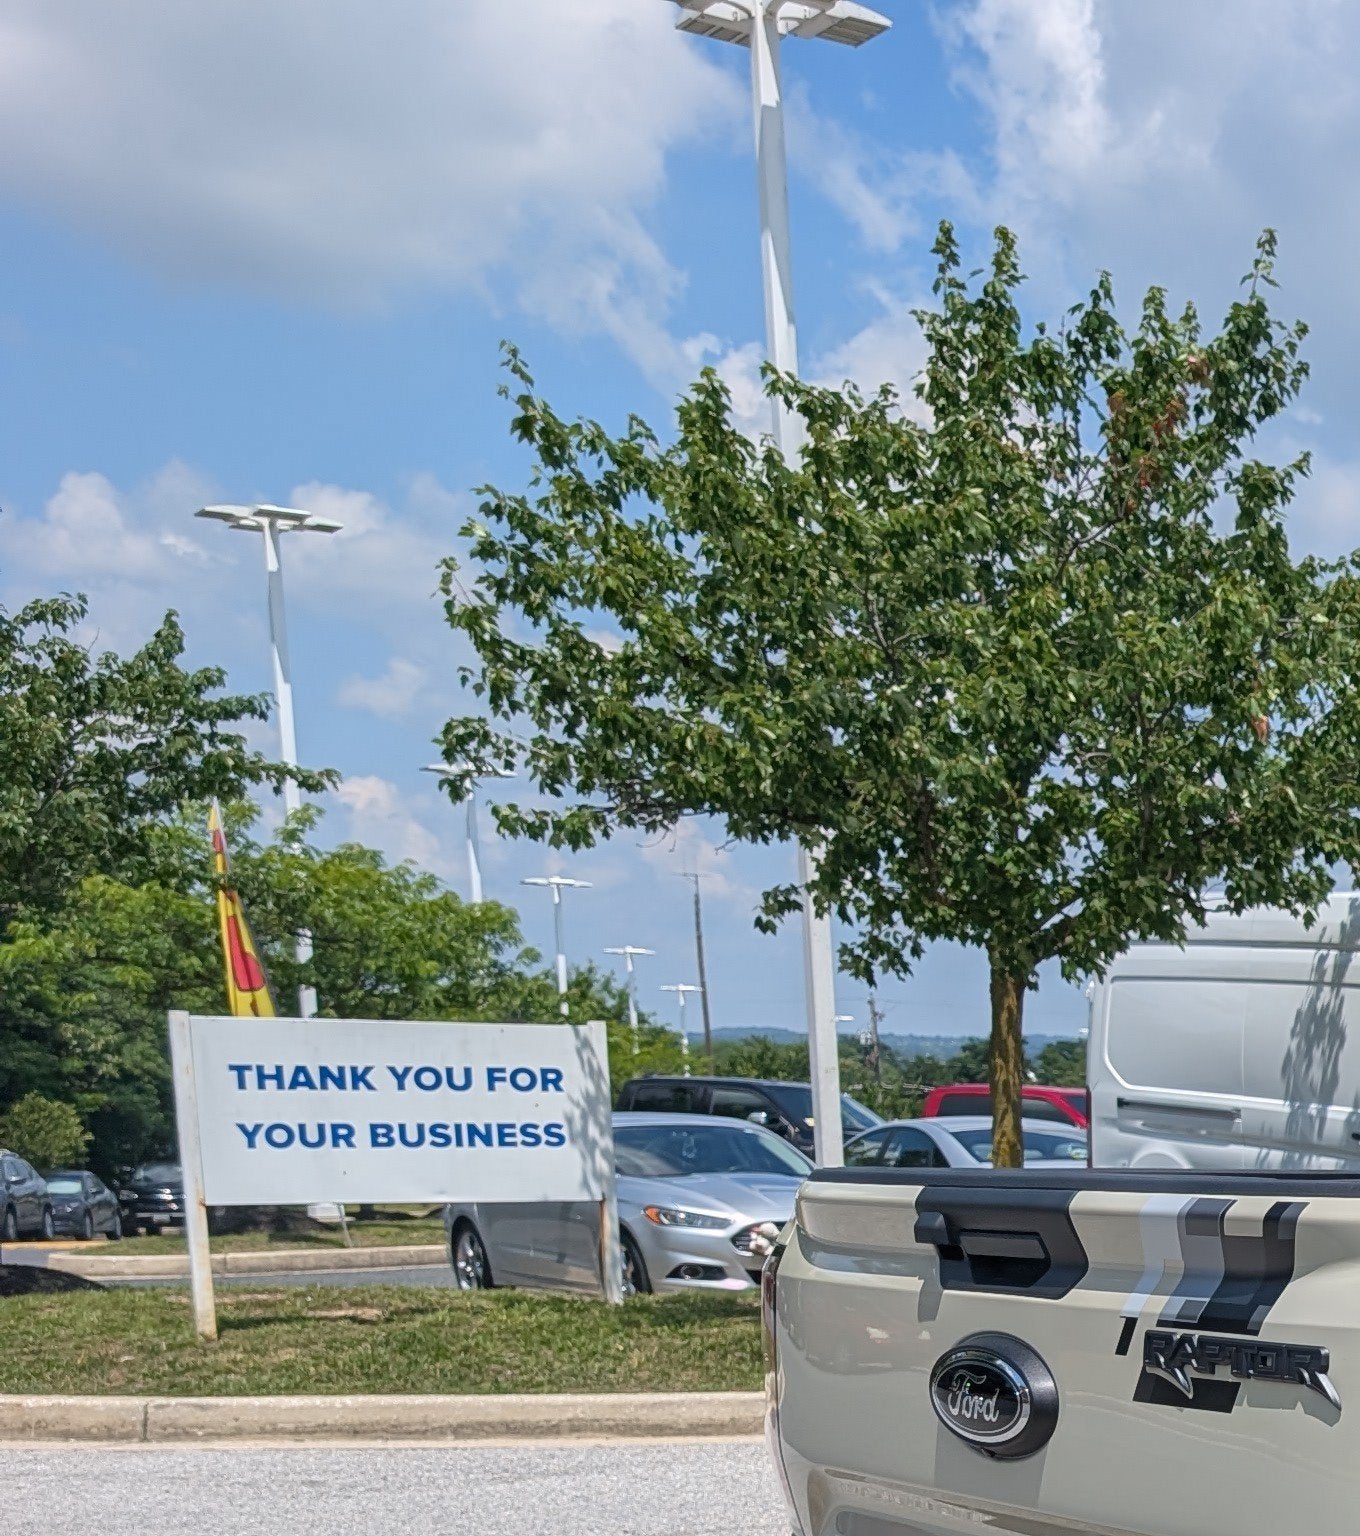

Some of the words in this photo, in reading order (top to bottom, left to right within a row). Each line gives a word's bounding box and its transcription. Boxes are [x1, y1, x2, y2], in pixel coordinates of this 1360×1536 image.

[228, 1064, 377, 1091] THANK
[386, 1065, 473, 1092] YOU
[487, 1067, 564, 1092] FOR
[235, 1123, 357, 1149] YOUR
[370, 1123, 566, 1148] BUSINESS
[1144, 1330, 1342, 1411] RAPTOR
[945, 1366, 1002, 1424] Ford
